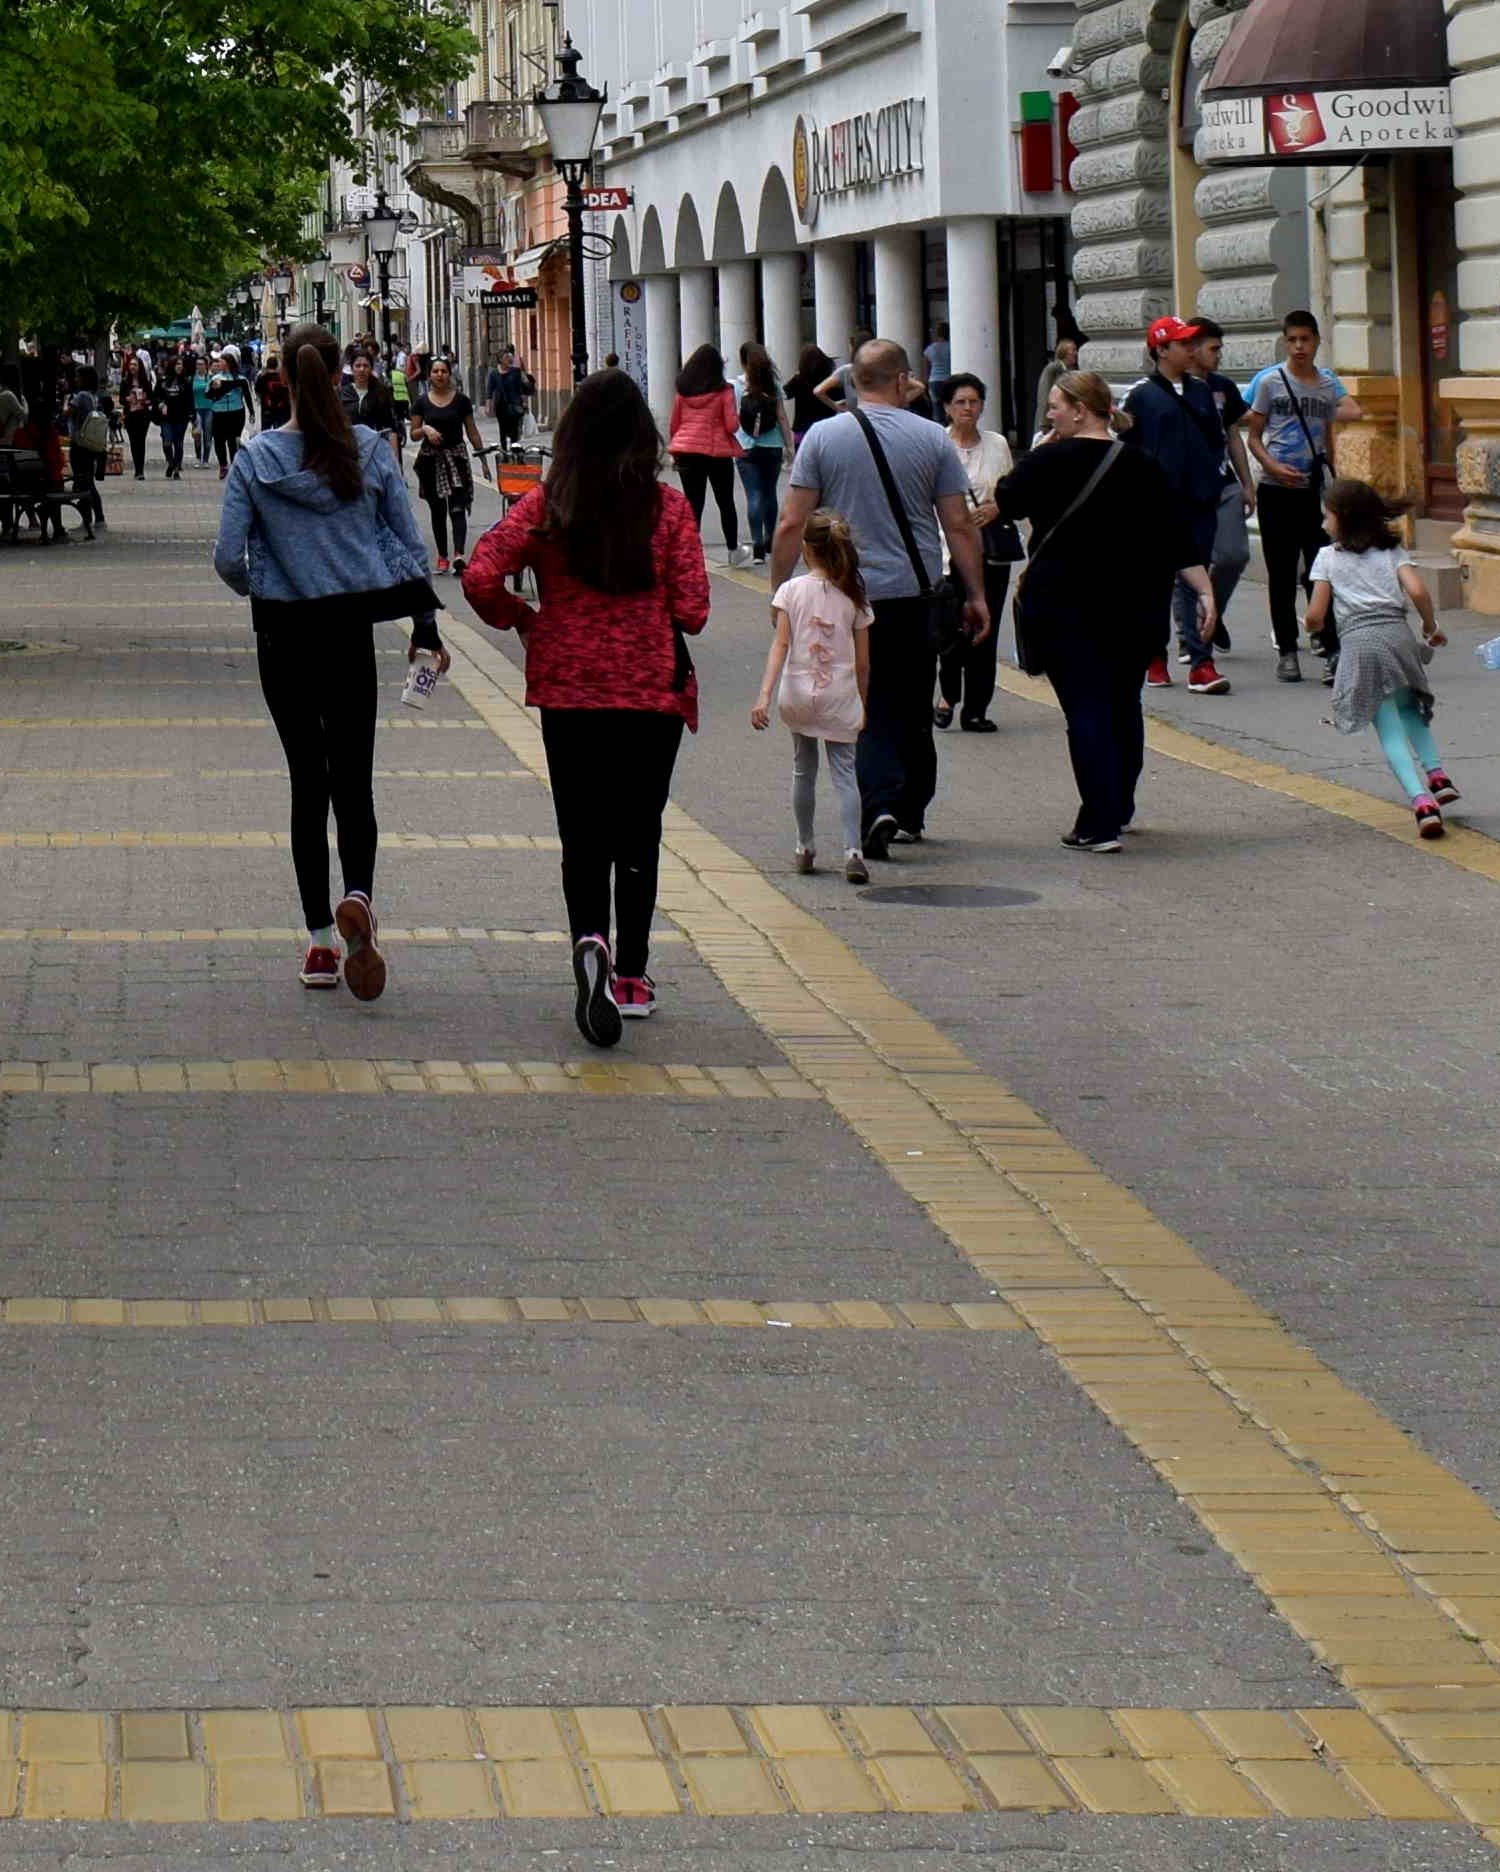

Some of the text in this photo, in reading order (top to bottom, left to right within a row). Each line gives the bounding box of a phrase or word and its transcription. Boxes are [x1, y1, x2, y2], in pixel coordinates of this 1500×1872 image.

[876, 97, 914, 179] CITY
[1338, 120, 1454, 147] Apoteka
[483, 293, 532, 305] BOMAR
